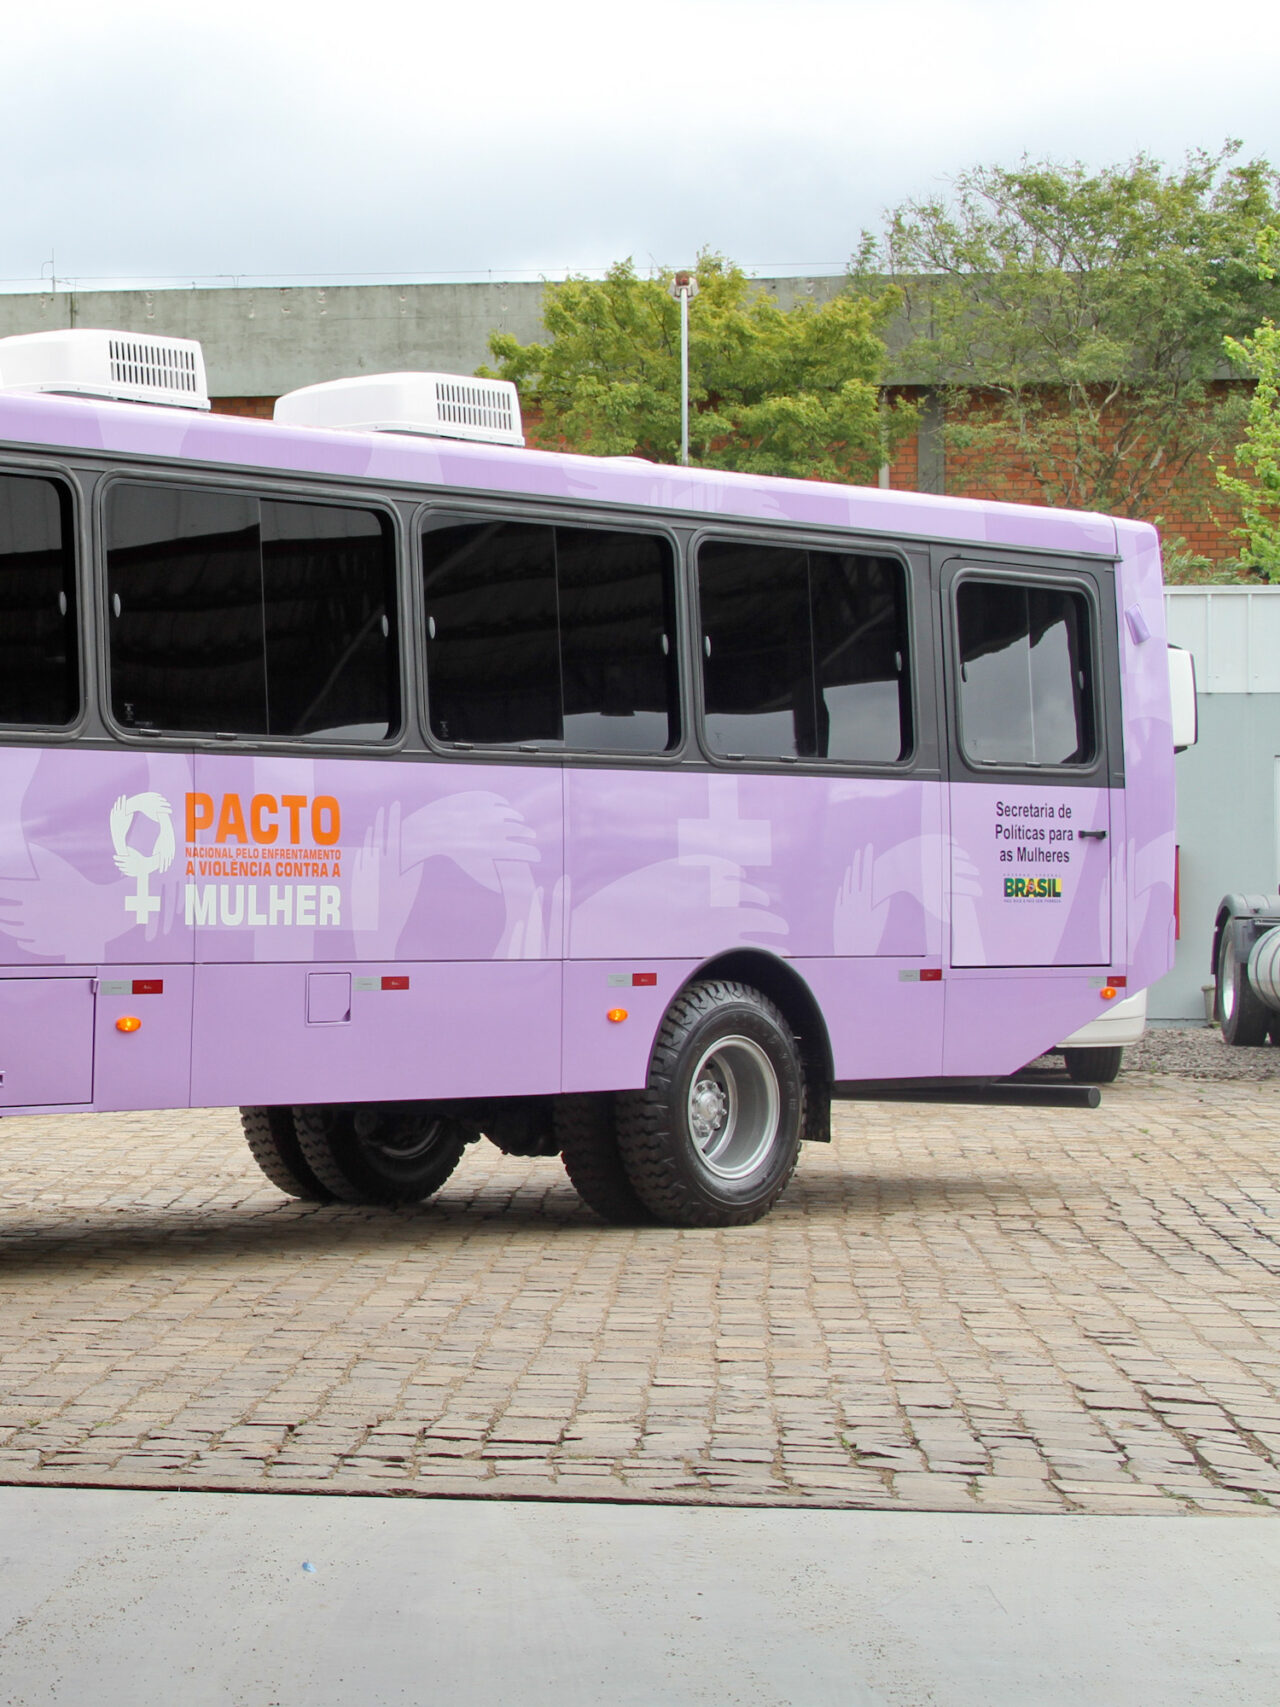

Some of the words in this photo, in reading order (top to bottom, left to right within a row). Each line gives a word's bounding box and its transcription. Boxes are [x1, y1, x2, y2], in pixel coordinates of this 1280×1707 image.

[184, 792, 341, 846] PACTO
[995, 801, 1055, 818] Secretaria
[1058, 803, 1072, 819] de
[995, 824, 1045, 841] Políticas
[1049, 828, 1074, 845] para
[185, 847, 233, 859] NACIONAL
[236, 848, 259, 860] PELO
[262, 849, 341, 861] ENFRENTAMENTO
[1000, 850, 1013, 862] as
[1017, 846, 1070, 863] Mulheres
[185, 861, 196, 876] A
[199, 858, 272, 877] VIOLÊNCIA
[275, 862, 329, 878] CONTRA
[332, 863, 341, 878] A
[1003, 878, 1063, 898] BRASIL
[184, 884, 341, 926] MULHER
